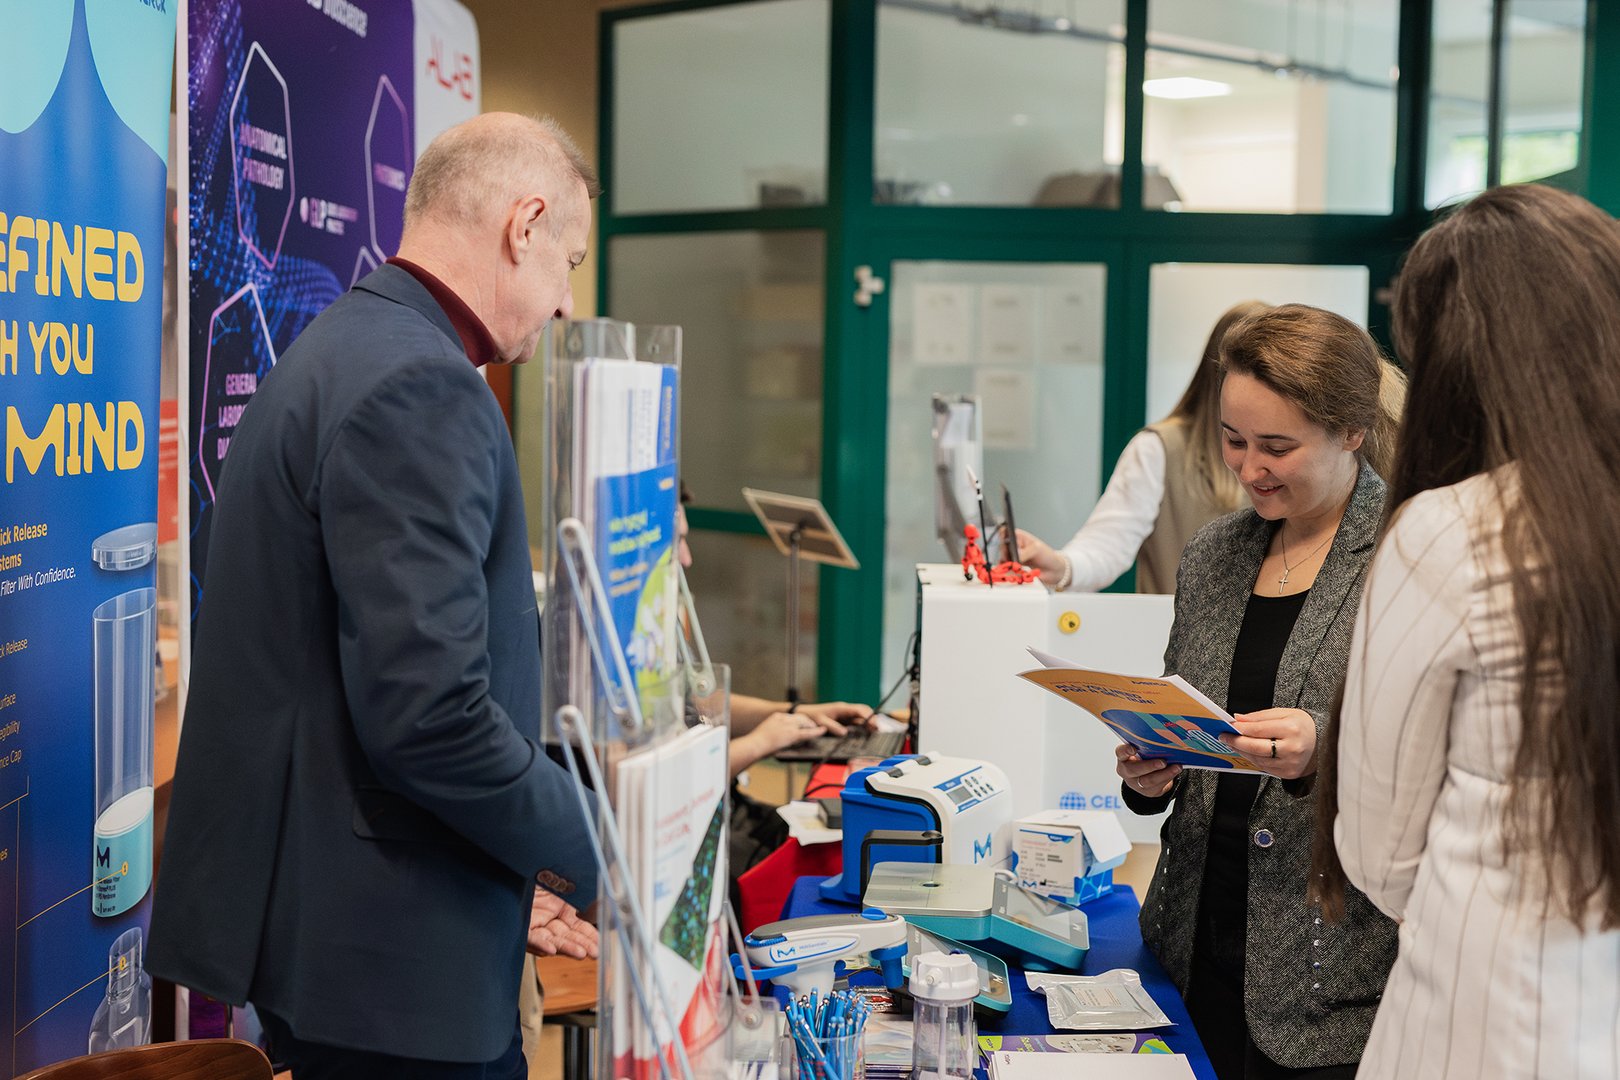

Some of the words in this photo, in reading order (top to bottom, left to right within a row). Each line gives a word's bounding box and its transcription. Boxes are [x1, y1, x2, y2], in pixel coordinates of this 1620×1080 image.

[0, 211, 145, 303] FINED
[28, 321, 94, 375] YOU
[225, 373, 257, 396] GENERAL
[6, 401, 145, 483] MIND
[13, 523, 48, 543] Release
[18, 574, 34, 591] With
[35, 567, 76, 587] Confidence.
[96, 845, 110, 869] M
